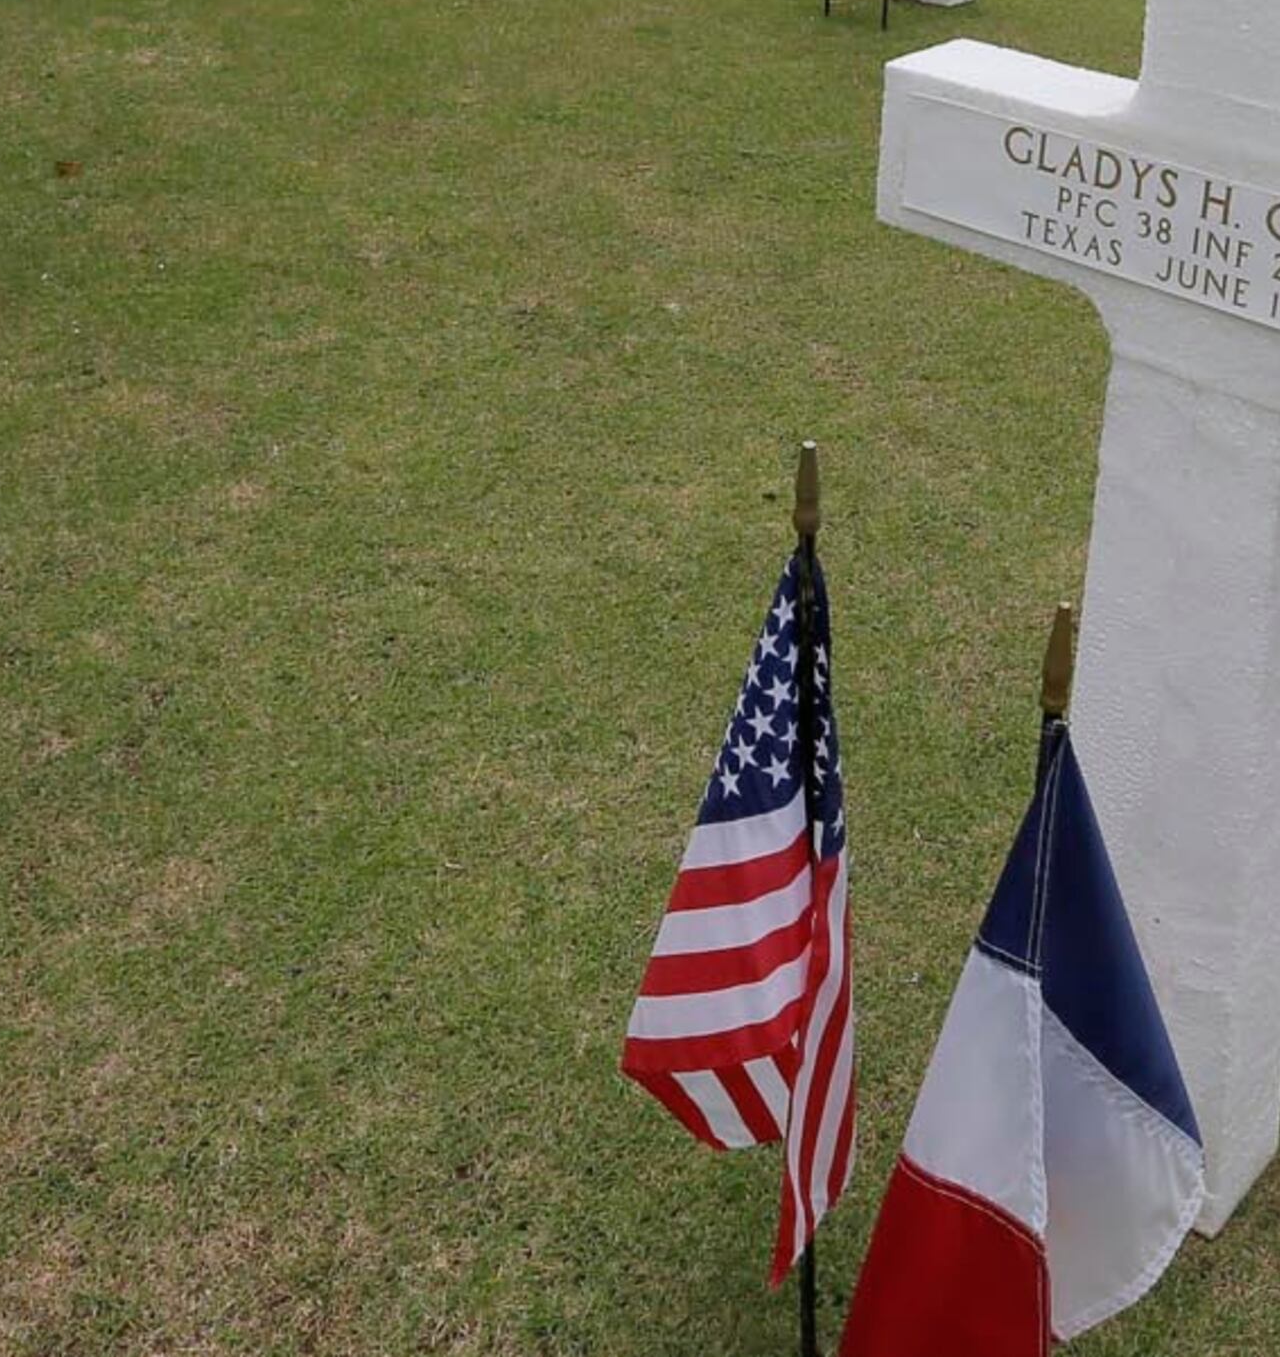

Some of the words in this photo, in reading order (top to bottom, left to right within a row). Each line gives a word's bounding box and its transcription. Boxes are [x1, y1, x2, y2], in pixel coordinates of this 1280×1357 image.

[1004, 126, 1179, 209] GLADYS
[1021, 212, 1122, 265] TEXAS
[1156, 259, 1248, 308] JUNE
[1057, 187, 1117, 228] PFC
[1137, 212, 1173, 245] 38
[1192, 228, 1253, 269] INF
